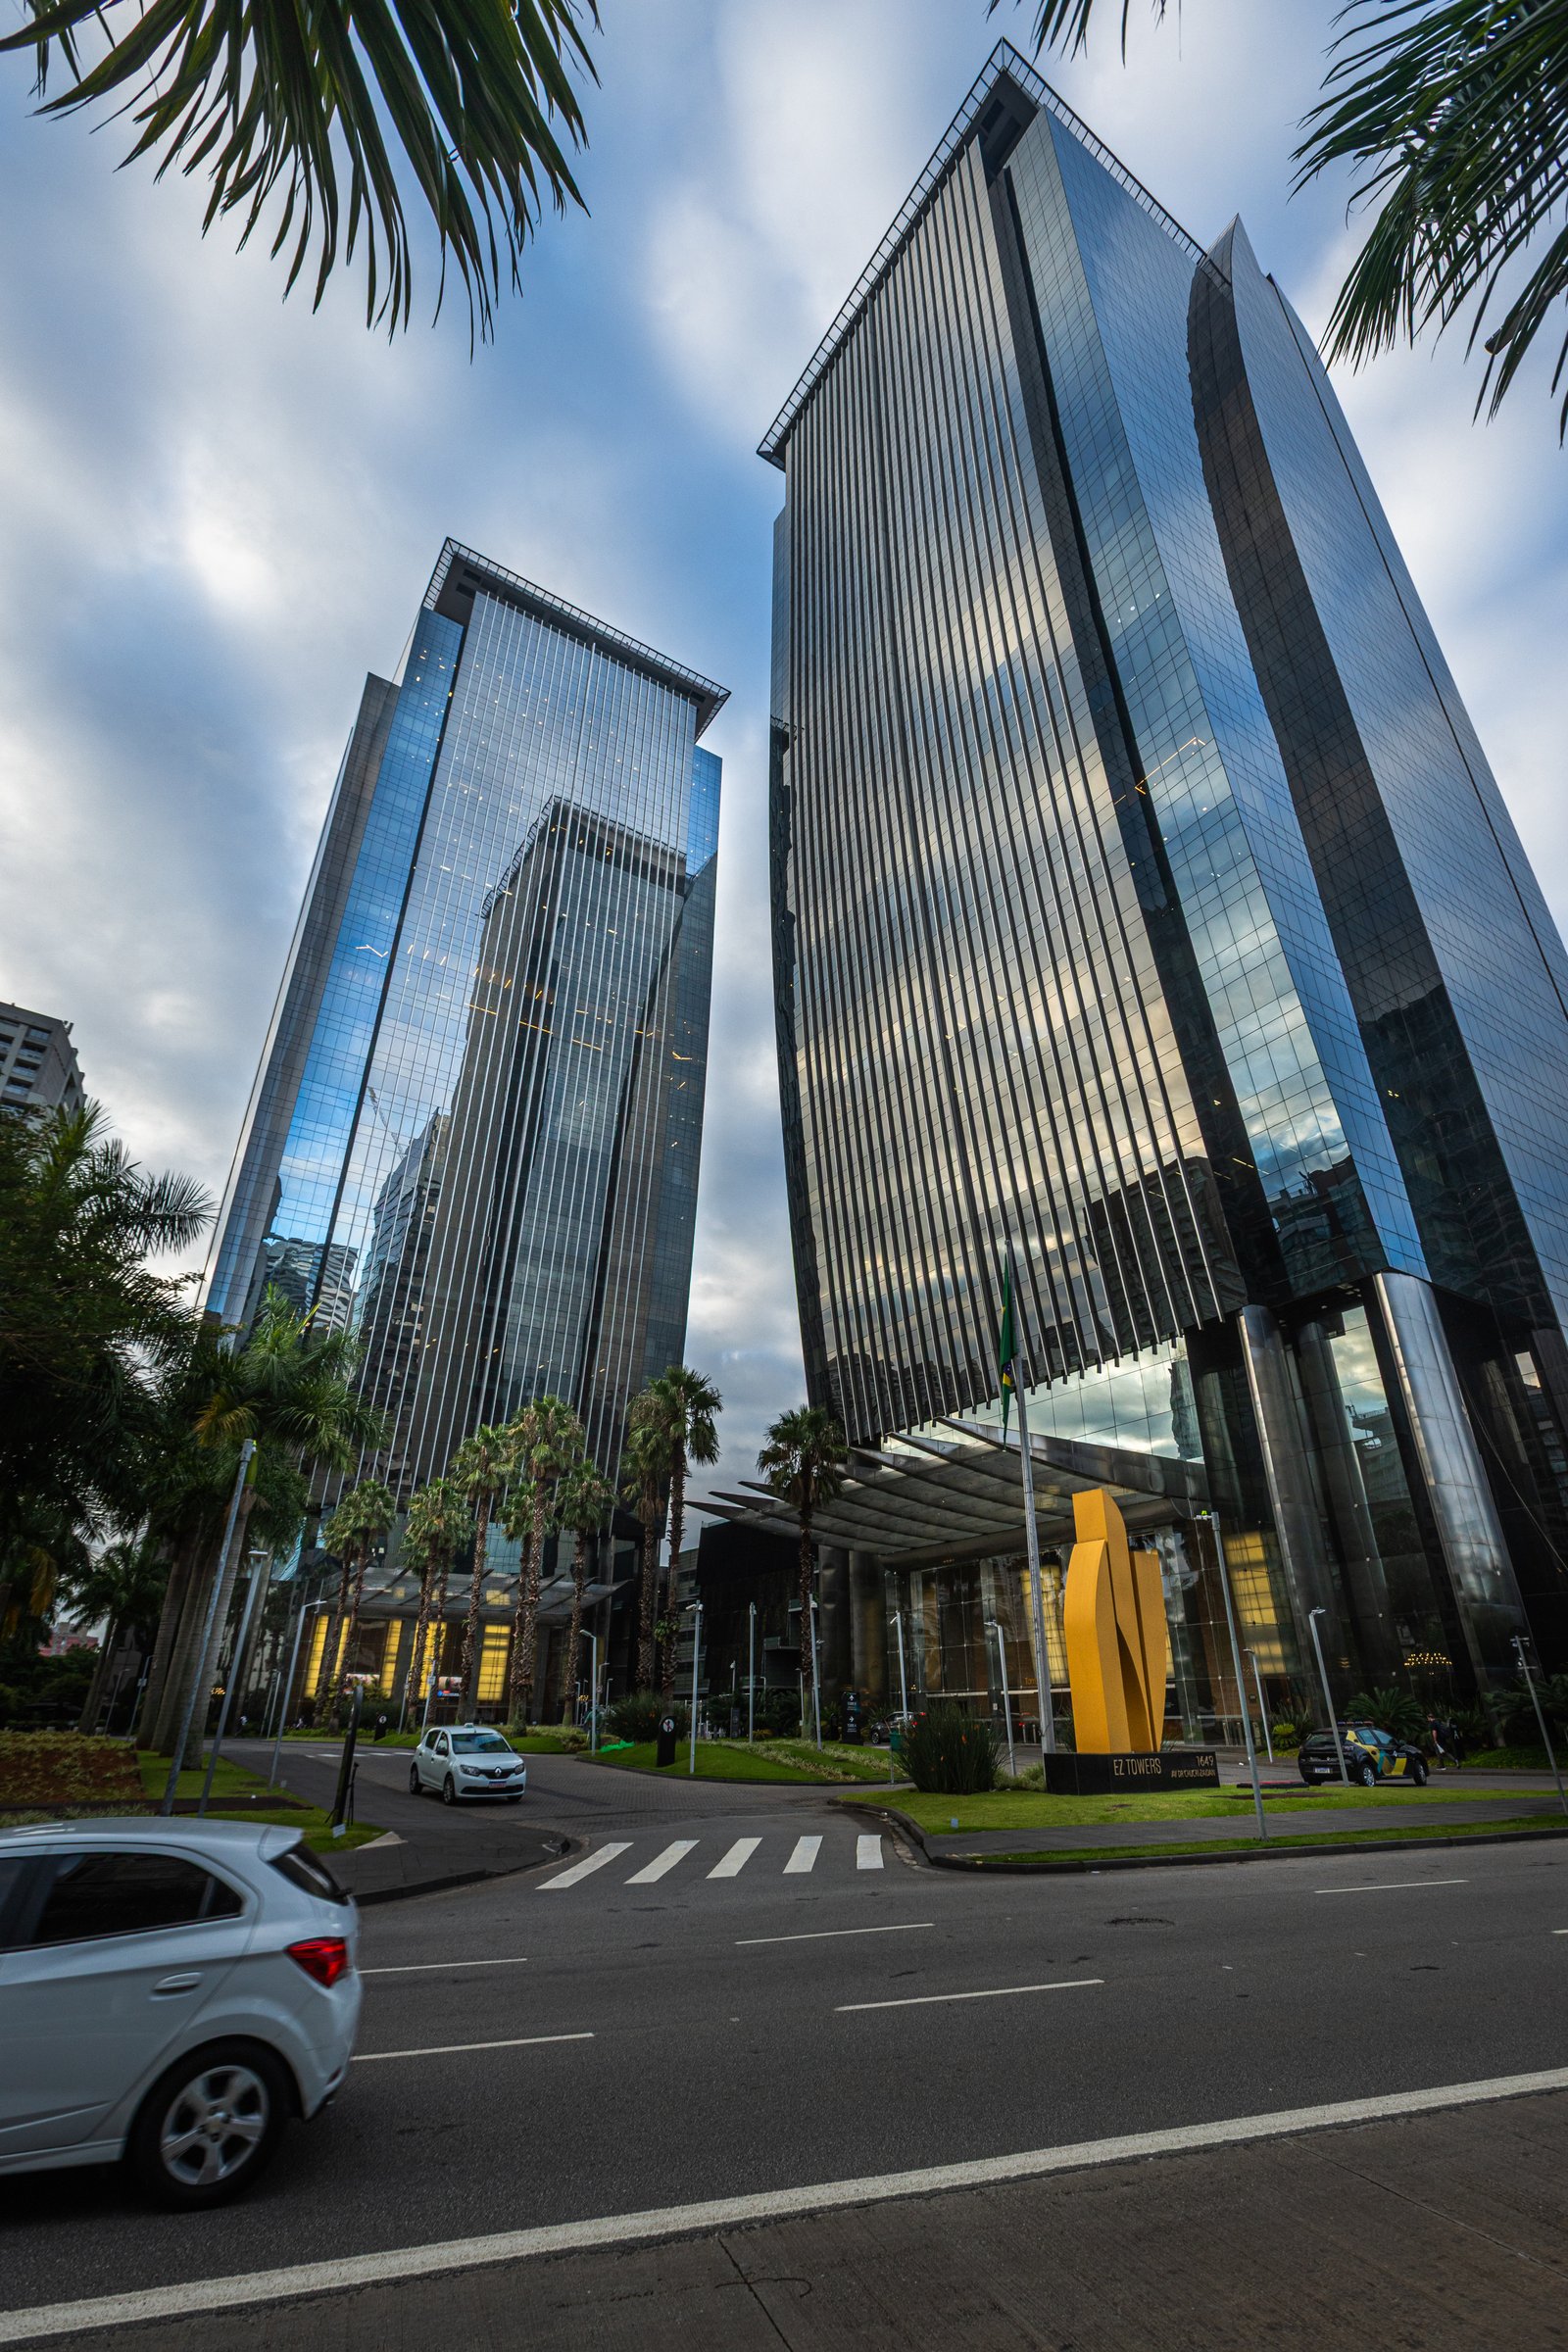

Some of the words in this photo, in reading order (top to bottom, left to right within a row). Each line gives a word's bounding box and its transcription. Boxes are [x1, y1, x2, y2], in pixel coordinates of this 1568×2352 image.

[1113, 1759, 1125, 1776] EZ
[1126, 1757, 1162, 1776] TOWERS
[1196, 1755, 1214, 1767] 1649
